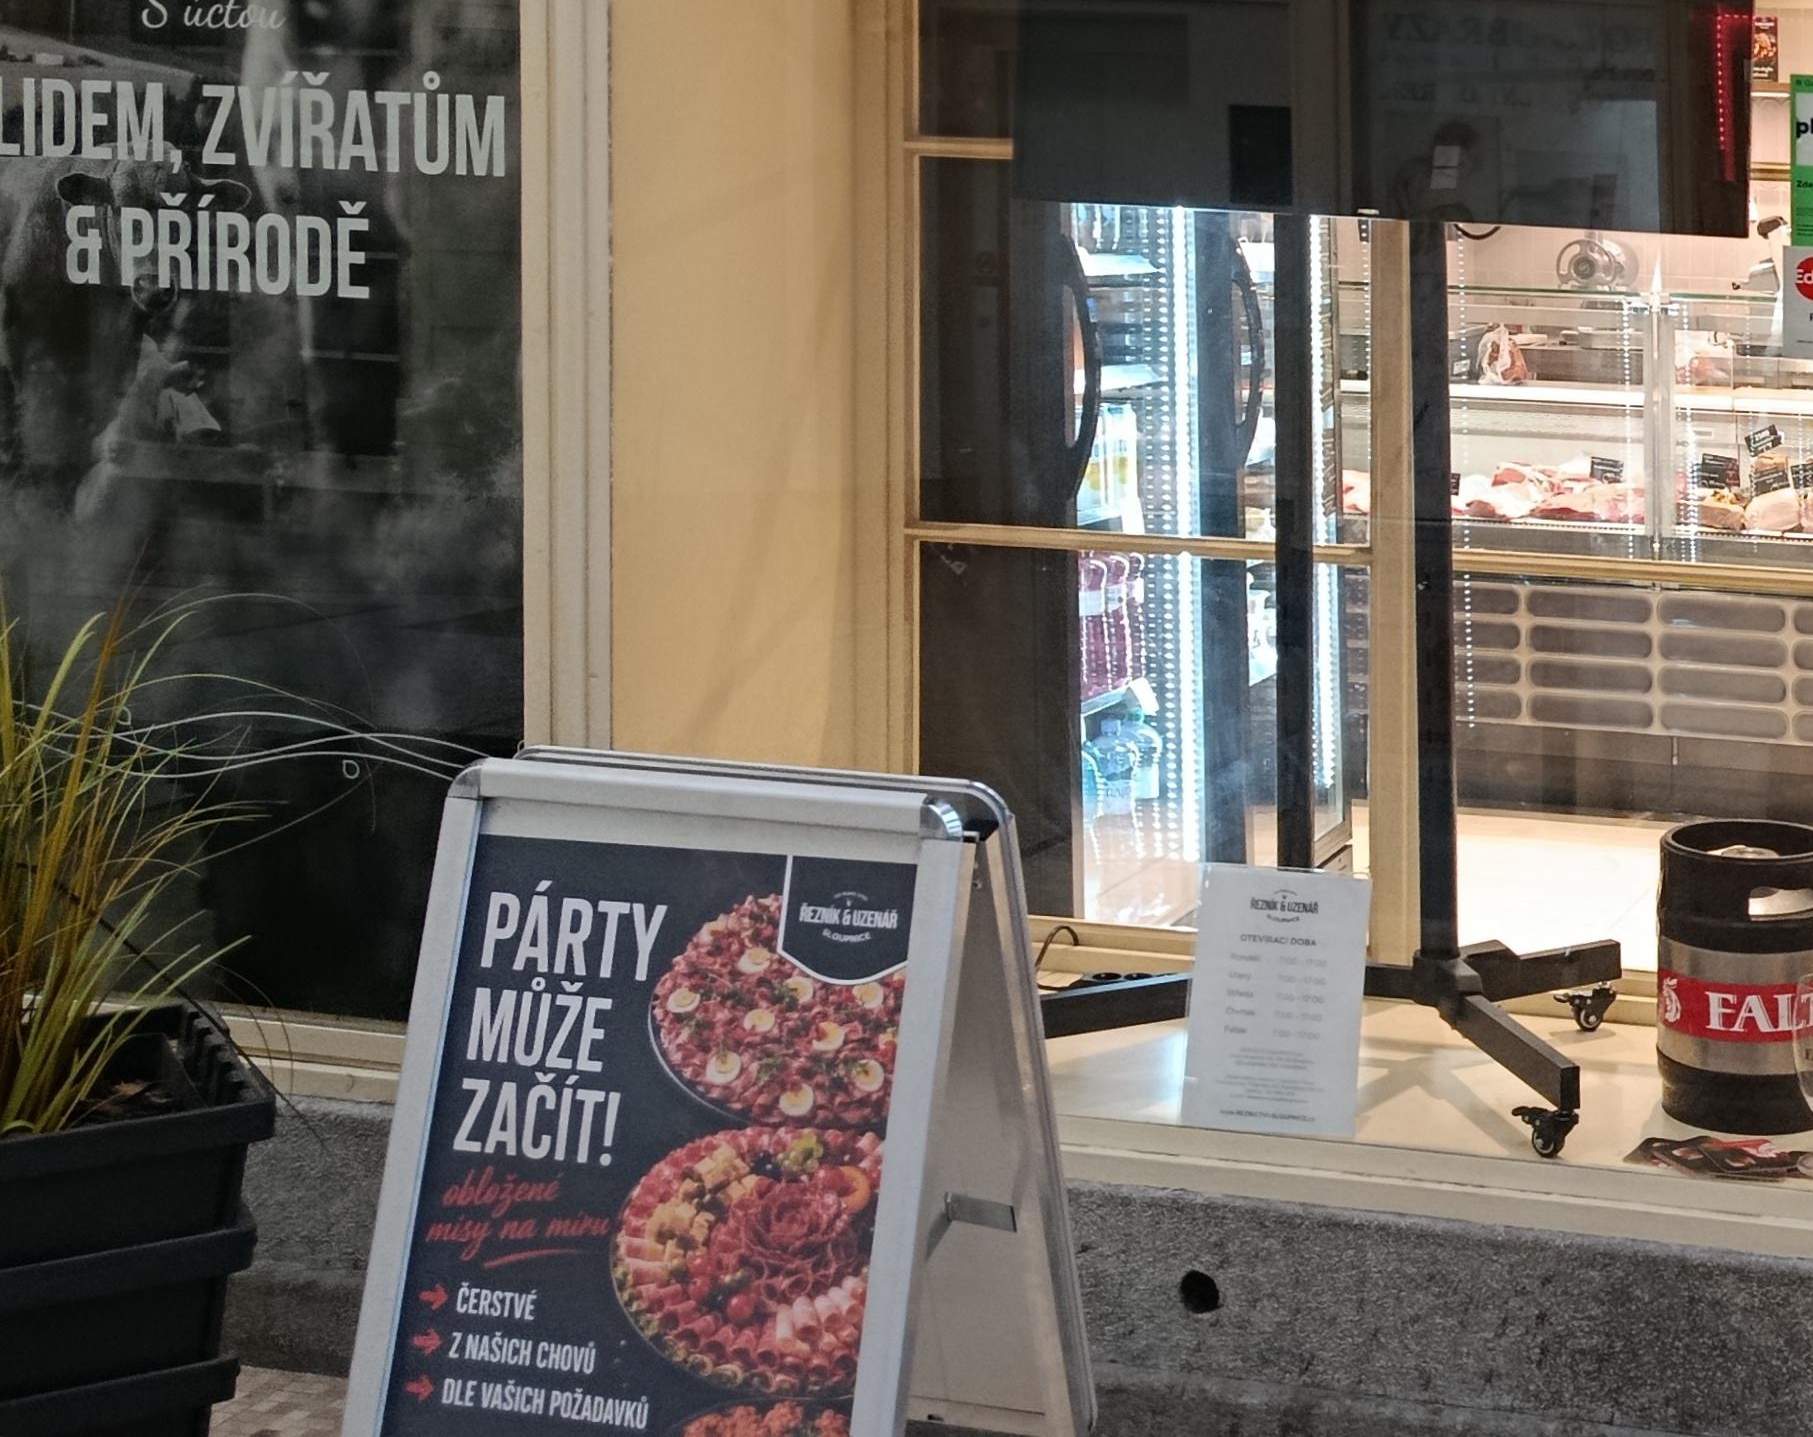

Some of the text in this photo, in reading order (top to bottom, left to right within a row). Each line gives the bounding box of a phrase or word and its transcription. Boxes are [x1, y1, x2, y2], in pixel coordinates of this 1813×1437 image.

[0, 70, 507, 178] LIDEM, ZVÍŘATŮM
[1796, 180, 1813, 188] Zde
[65, 192, 371, 300] & PŘÍRODĚ
[480, 879, 669, 982] PÁRTY
[799, 903, 899, 930] ŘEZNÍK & UZENÁŘ
[466, 976, 613, 1072] MŮŽE
[453, 1071, 622, 1167] ZAČÍT!
[442, 1165, 564, 1218] obložené
[498, 1217, 537, 1241] na
[456, 1281, 537, 1321] ČERSTVÉ
[448, 1331, 597, 1375] Z NAŠICH CHOVŮ
[441, 1377, 650, 1430] DLE VAŠICH POŽADAVKŮ
